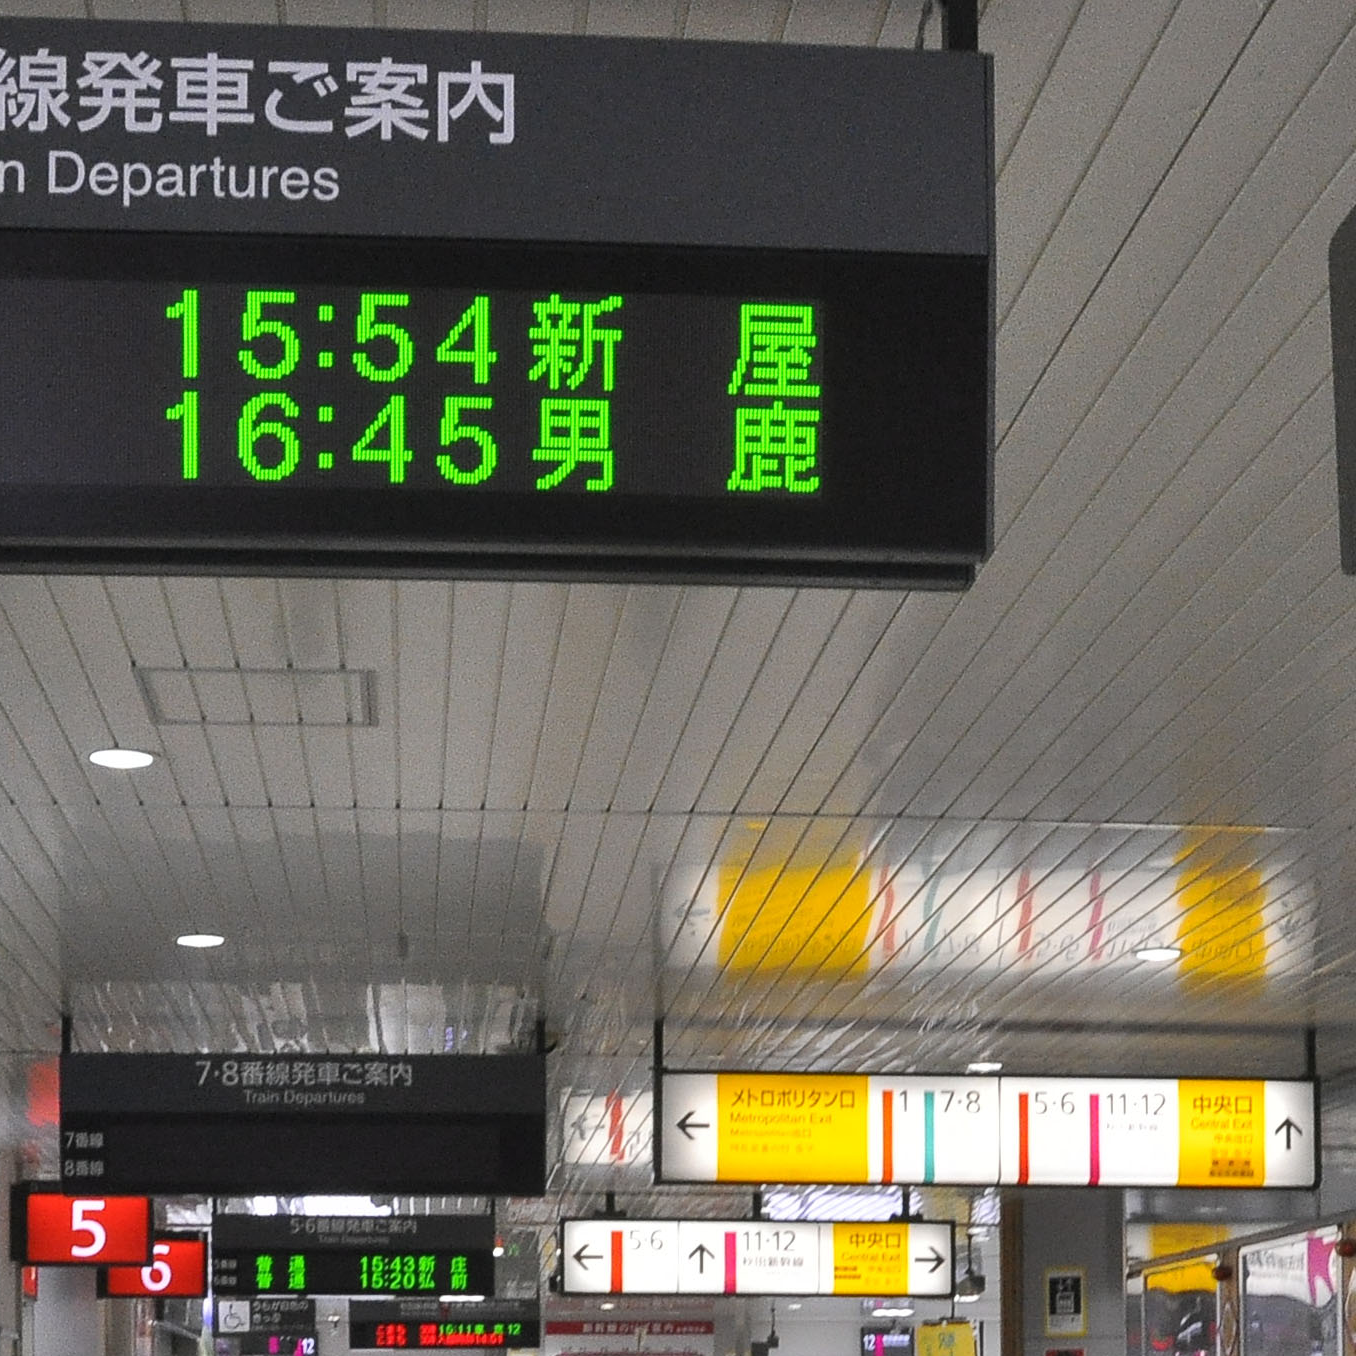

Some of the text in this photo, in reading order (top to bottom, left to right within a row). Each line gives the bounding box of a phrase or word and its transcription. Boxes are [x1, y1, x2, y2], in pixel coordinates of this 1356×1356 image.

[47, 150, 341, 206] Departures
[166, 288, 498, 384] 15:54
[166, 391, 498, 485] 16:45
[244, 1089, 366, 1107] Train Departures
[730, 1088, 856, 1109] メトロポリタン口
[899, 1089, 909, 1113] 1
[1192, 1093, 1253, 1116] 中央口
[729, 1112, 806, 1126] Metropolitan
[1190, 1117, 1230, 1131] Central
[70, 1200, 108, 1257] 5
[849, 1232, 901, 1249] 中央口
[140, 1245, 172, 1292] 6
[302, 1337, 315, 1355] 12
[863, 1334, 876, 1351] 12
